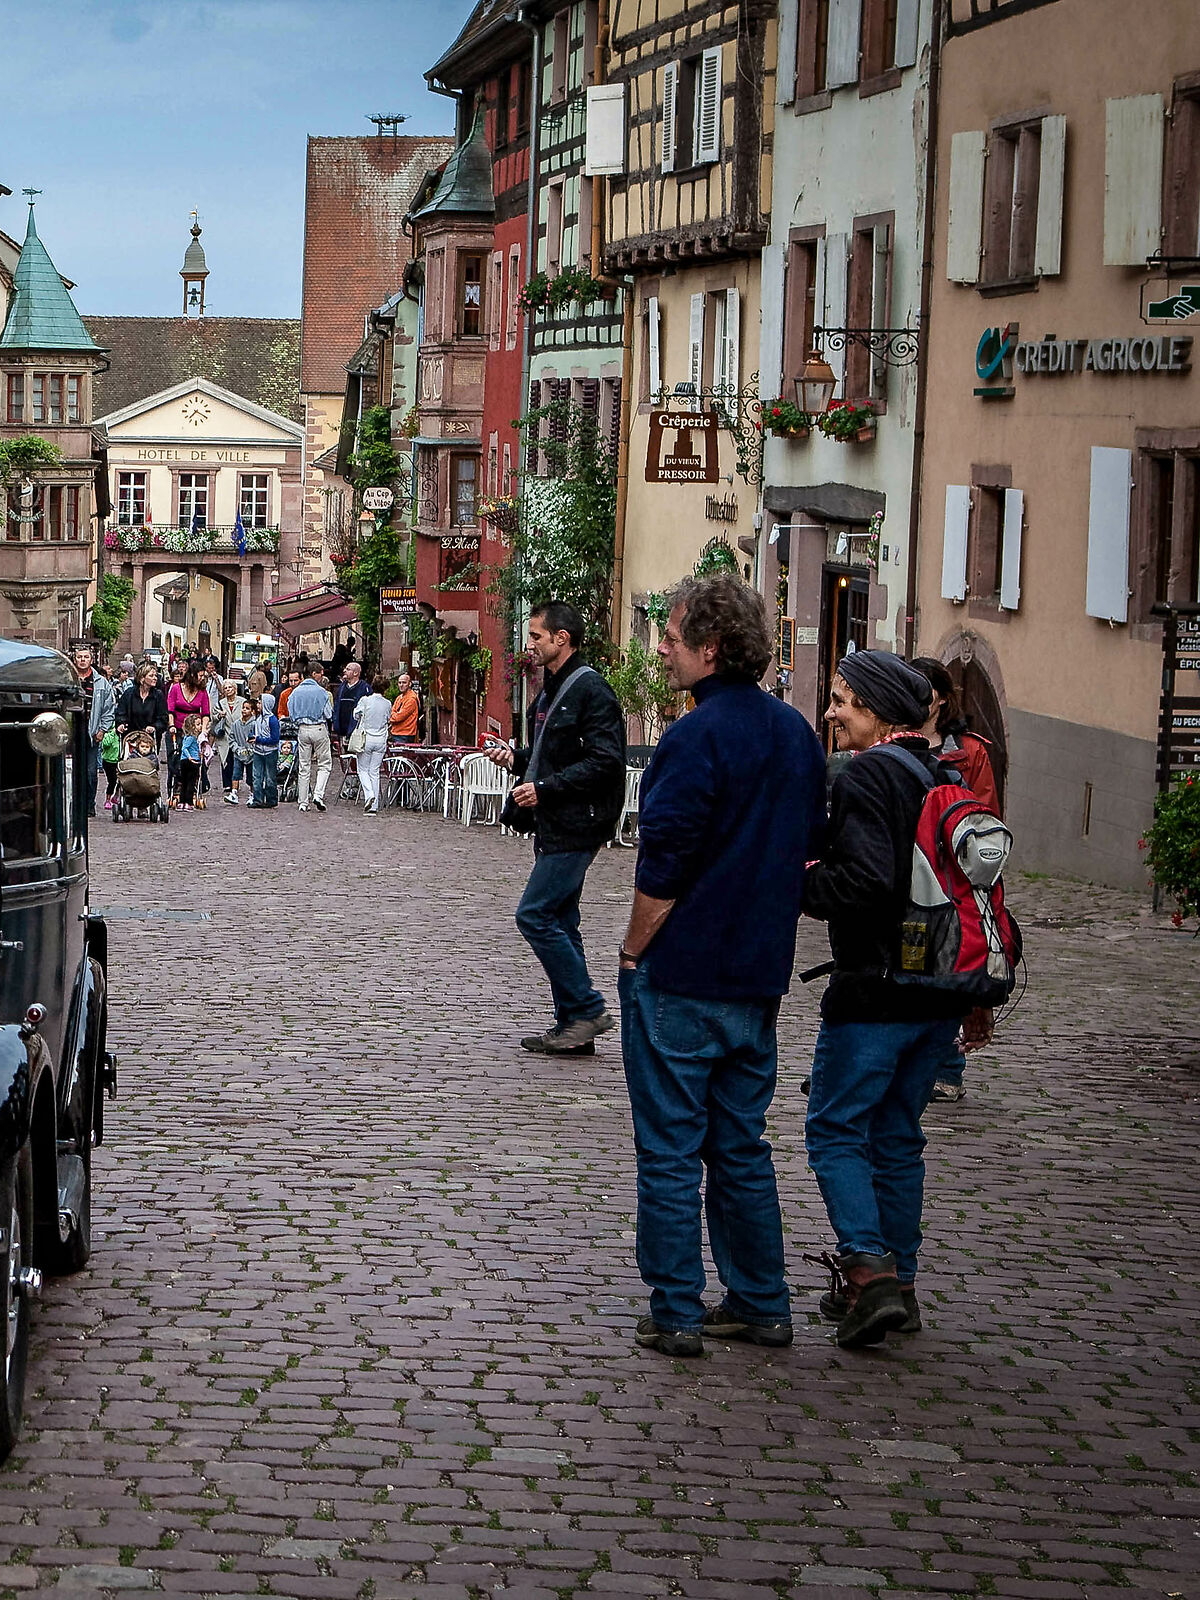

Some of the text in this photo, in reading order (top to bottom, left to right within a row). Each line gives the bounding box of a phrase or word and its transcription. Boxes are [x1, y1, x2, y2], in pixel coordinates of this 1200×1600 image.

[1014, 333, 1193, 373] CRÉDIT AGRICOLE
[658, 414, 711, 430] Crêperie
[138, 449, 250, 462] HOTEL DE VILLE
[657, 469, 707, 480] PRESSOIR
[365, 489, 390, 499] Au Cep
[1188, 621, 1199, 631] La
[1172, 717, 1182, 726] AU
